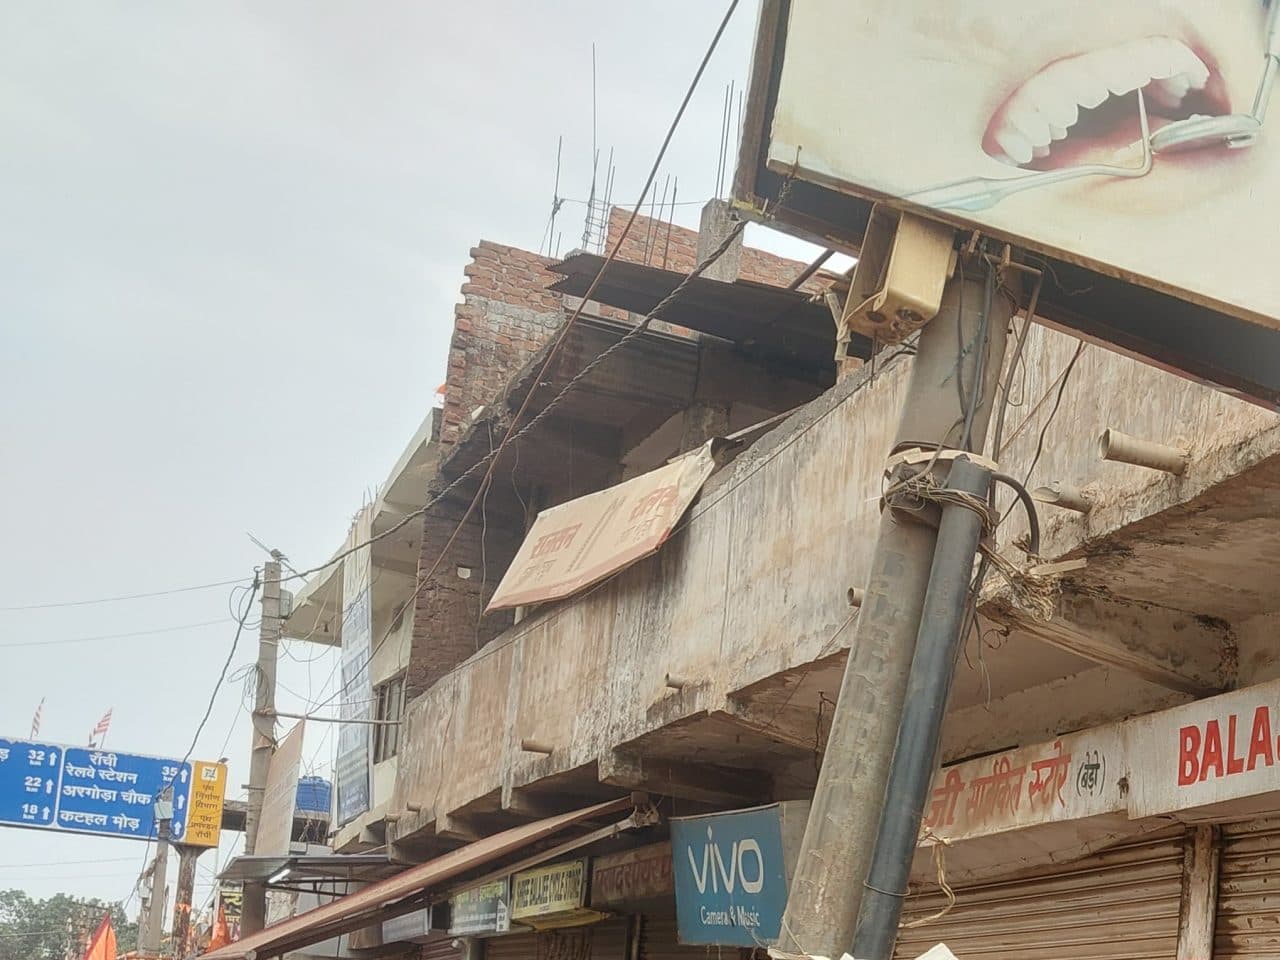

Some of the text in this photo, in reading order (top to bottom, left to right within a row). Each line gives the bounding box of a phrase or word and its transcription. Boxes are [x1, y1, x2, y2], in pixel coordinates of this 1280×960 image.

[27, 750, 46, 761] 32
[24, 776, 42, 787] 22
[65, 762, 138, 784] रेलवे स्टेशन
[63, 784, 153, 806] अरगोड़ा चौक
[22, 803, 39, 815] 18
[60, 810, 109, 826] कटहल
[112, 813, 141, 832] मोड़
[699, 905, 730, 926] Camera
[736, 905, 761, 928] Music
